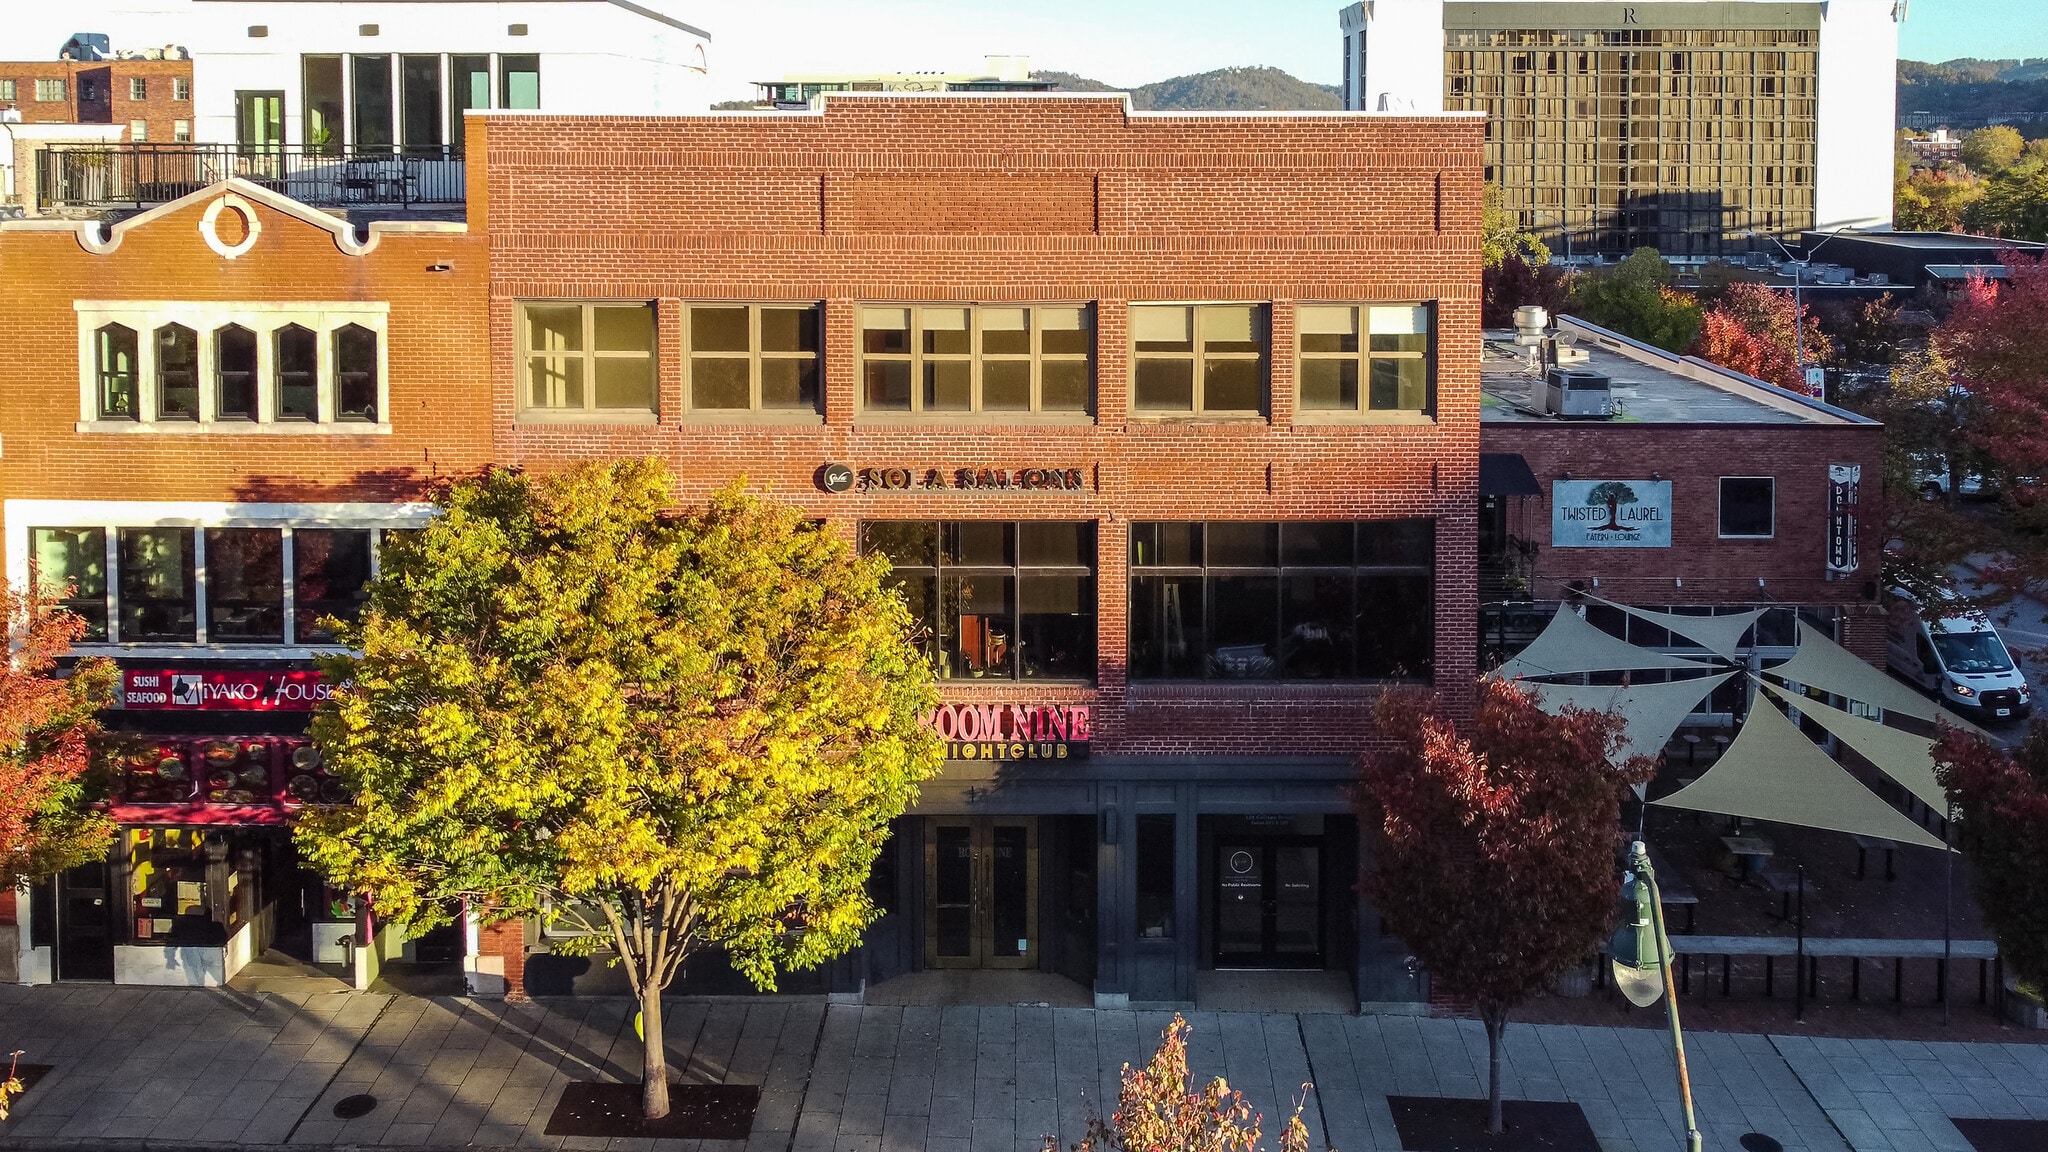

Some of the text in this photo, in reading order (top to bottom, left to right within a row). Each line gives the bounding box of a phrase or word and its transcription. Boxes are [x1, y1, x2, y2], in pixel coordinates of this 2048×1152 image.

[869, 468, 1084, 490] SOLA SALONS
[1561, 507, 1663, 521] TWISTED LAUREL
[1586, 532, 1641, 541] EATERY LOUNGE
[132, 675, 159, 687] SUSHI
[126, 692, 167, 704] SEAFOOD
[1010, 703, 1090, 741] NINE
